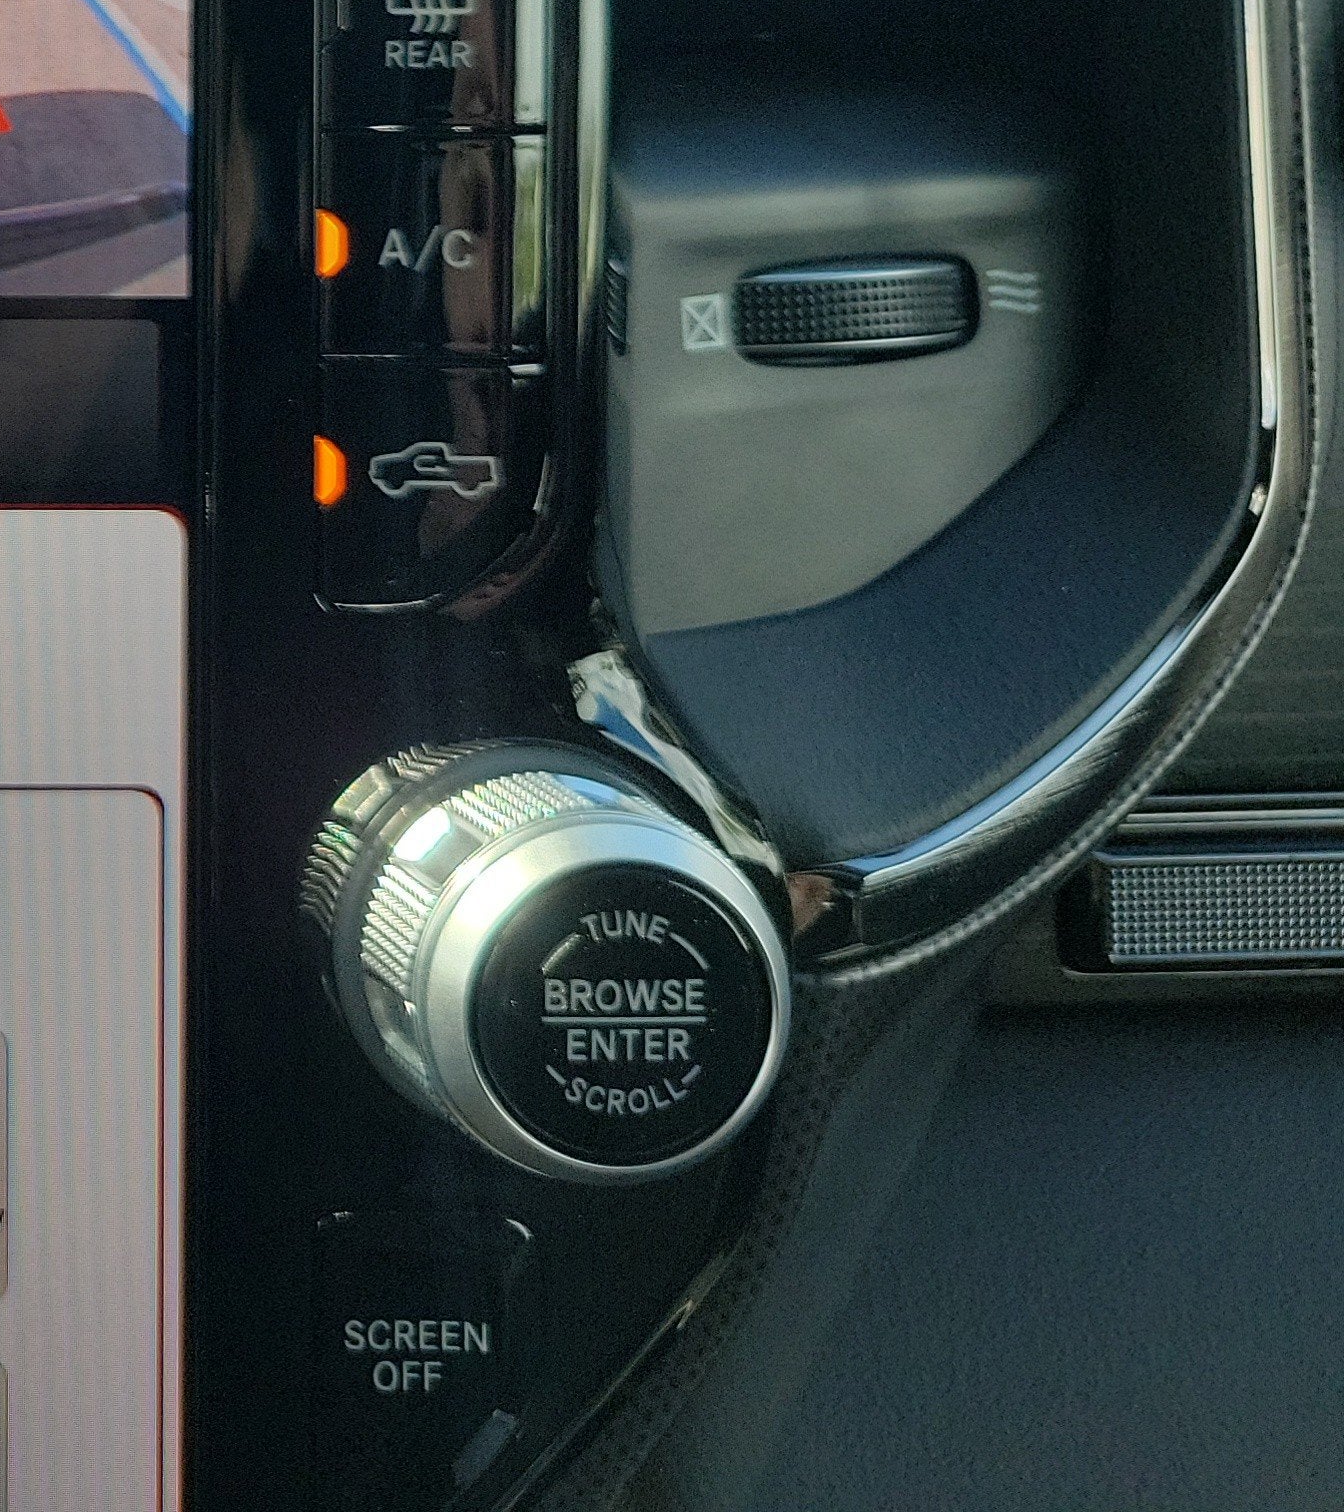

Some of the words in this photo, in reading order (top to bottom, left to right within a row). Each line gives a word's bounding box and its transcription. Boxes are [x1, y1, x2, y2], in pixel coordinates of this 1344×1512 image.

[386, 40, 475, 68] REAR
[378, 225, 473, 273] A/C
[579, 909, 671, 944] TUNE
[545, 978, 704, 1012] BROWSE
[567, 1028, 690, 1061] ENTER
[563, 1076, 689, 1116] SCROLL
[344, 1319, 489, 1354] SCREEN
[372, 1360, 442, 1392] OFF
